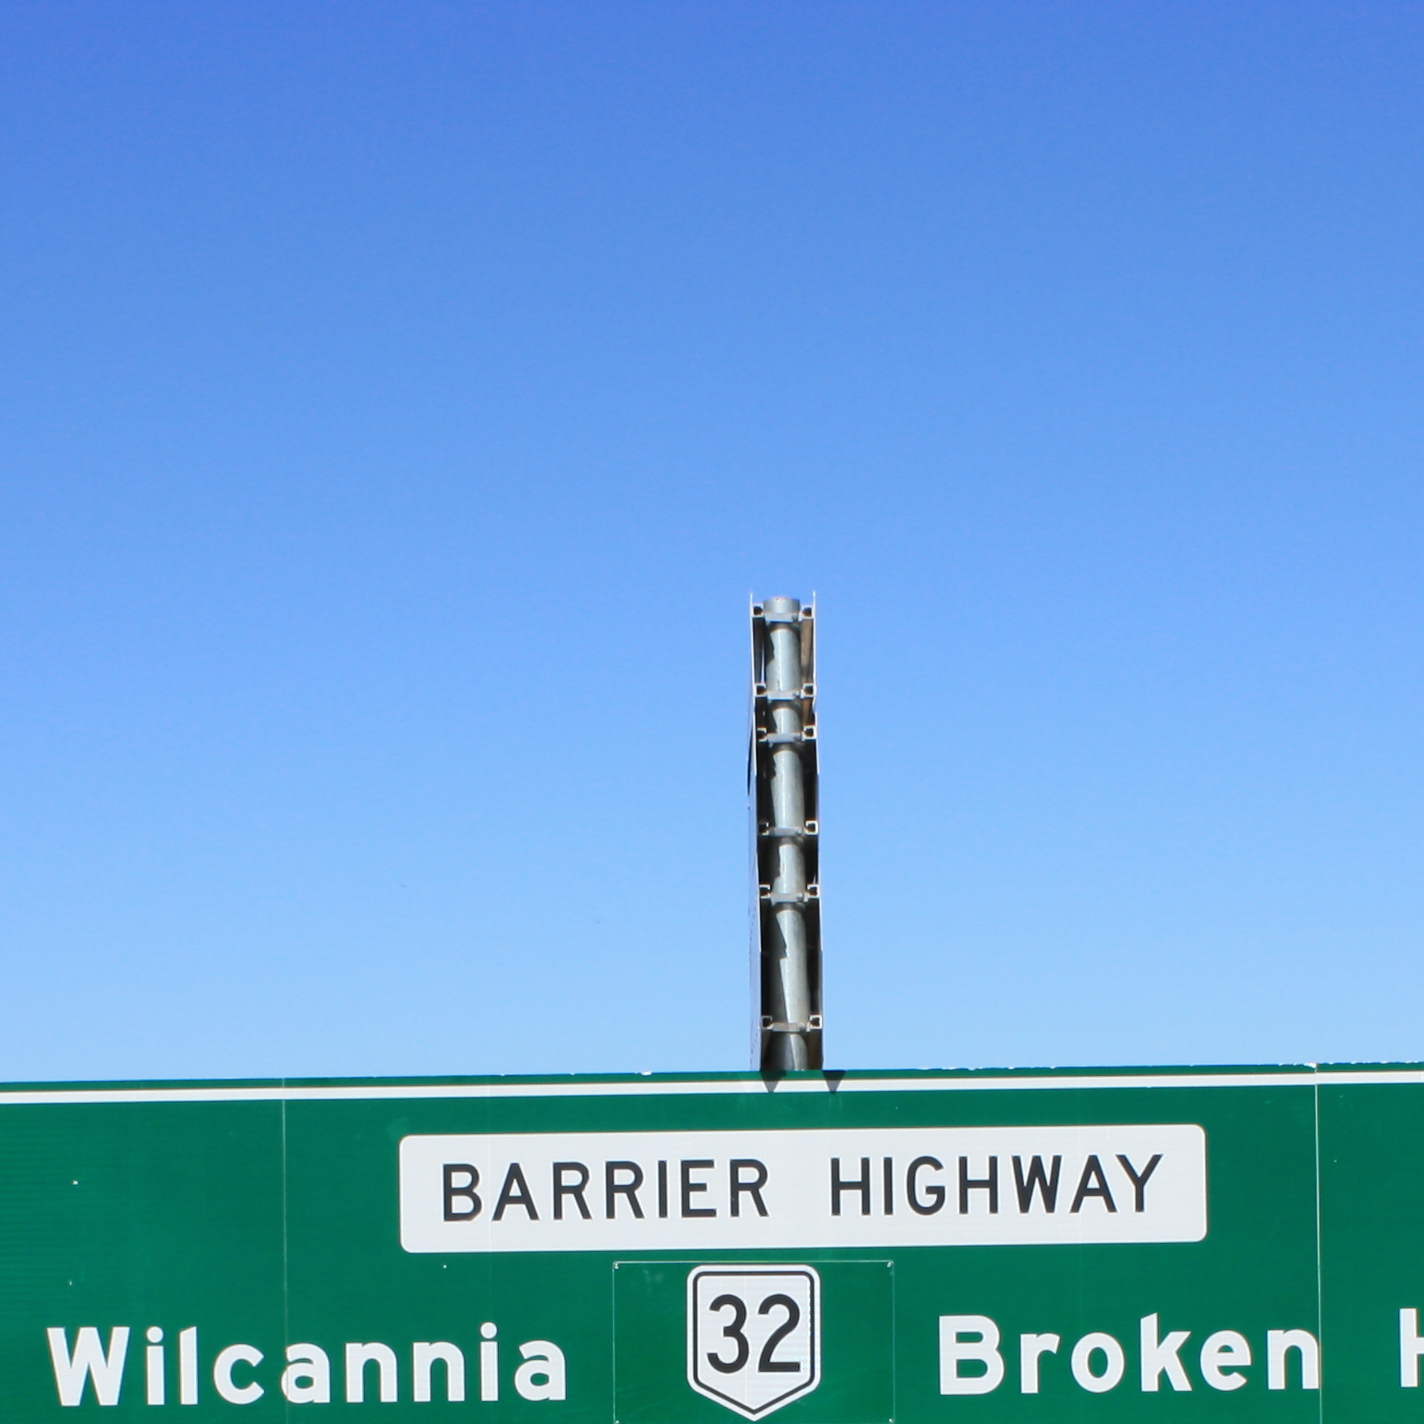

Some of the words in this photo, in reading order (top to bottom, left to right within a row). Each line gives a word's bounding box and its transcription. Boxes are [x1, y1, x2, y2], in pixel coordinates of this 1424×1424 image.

[442, 1159, 769, 1221] BARRIER
[830, 1155, 1163, 1216] HIGHWAY
[46, 1323, 567, 1407] Wilcannia
[707, 1294, 801, 1373] 32
[938, 1312, 1322, 1396] Broken
